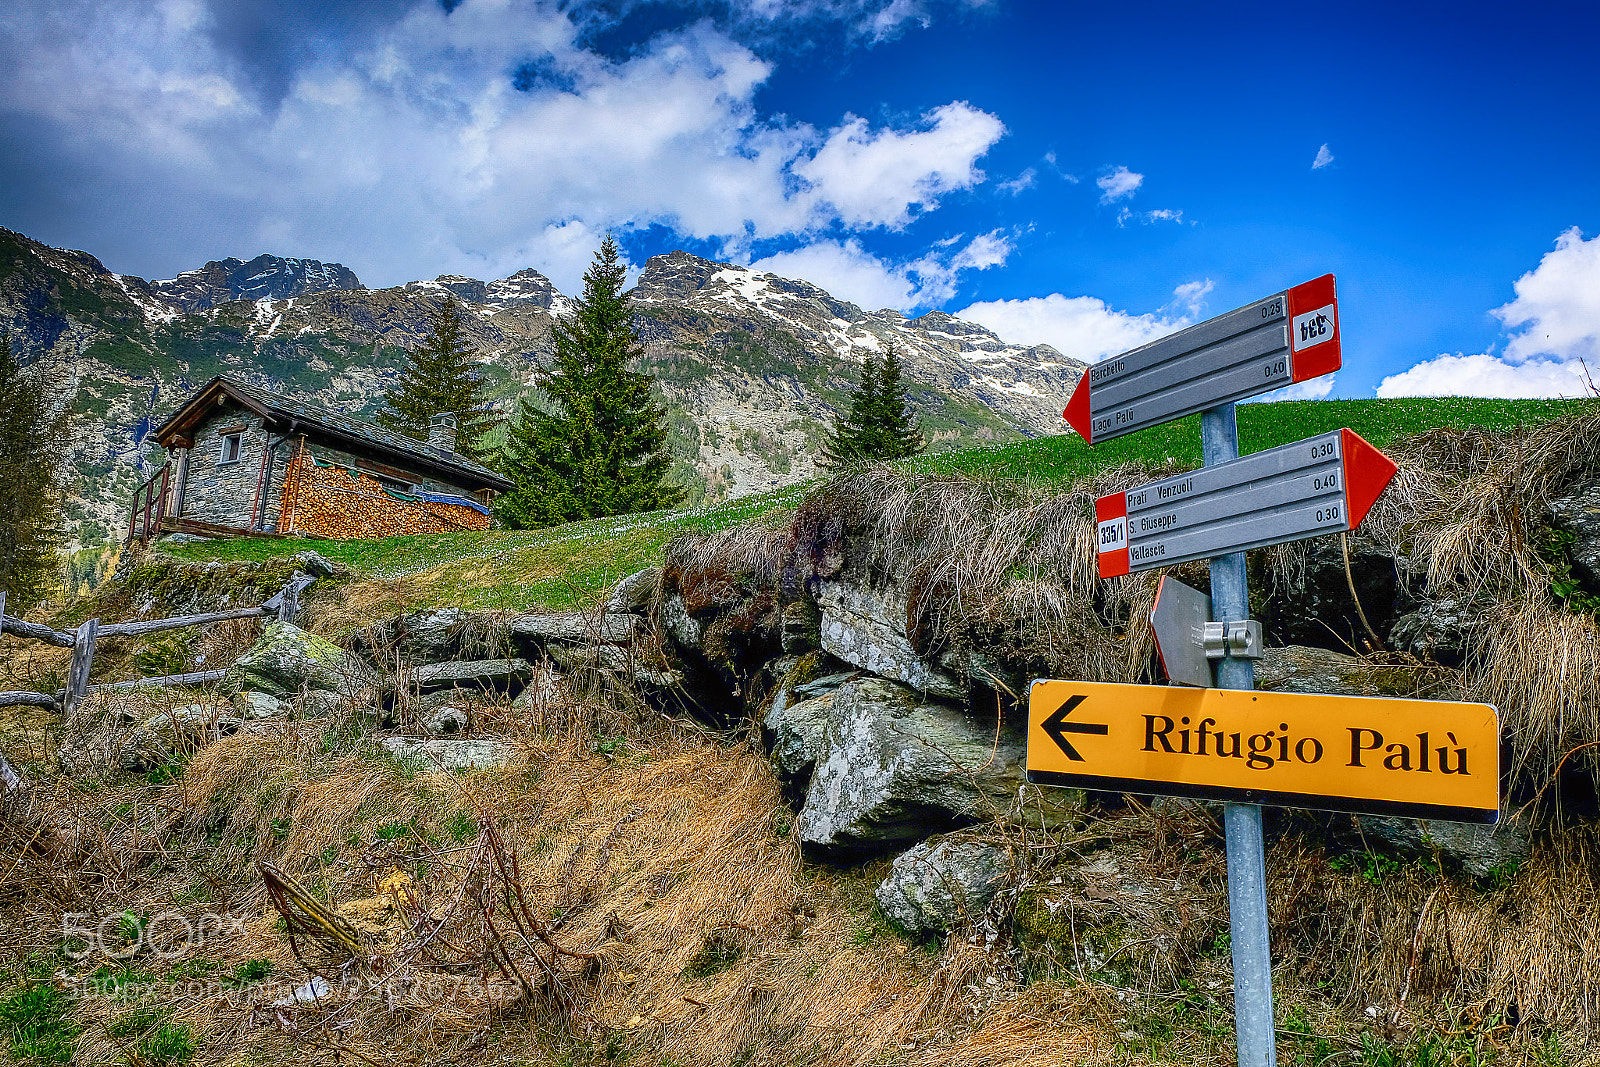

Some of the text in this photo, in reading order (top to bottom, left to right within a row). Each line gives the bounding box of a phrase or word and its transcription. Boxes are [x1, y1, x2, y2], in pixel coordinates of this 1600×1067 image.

[1091, 301, 1281, 382] Barchetto 0.25
[1300, 314, 1327, 342] 334
[1092, 418, 1112, 432] Lago
[1264, 361, 1285, 378] 0.40
[1127, 442, 1334, 508] Prati Venzuoli 0.30
[1129, 474, 1336, 534] S. Giuseppe 0.40
[1100, 522, 1124, 545] 335/1
[1130, 506, 1339, 561] Vallascia 0.30
[1140, 714, 1472, 777] Rifugio Palù
